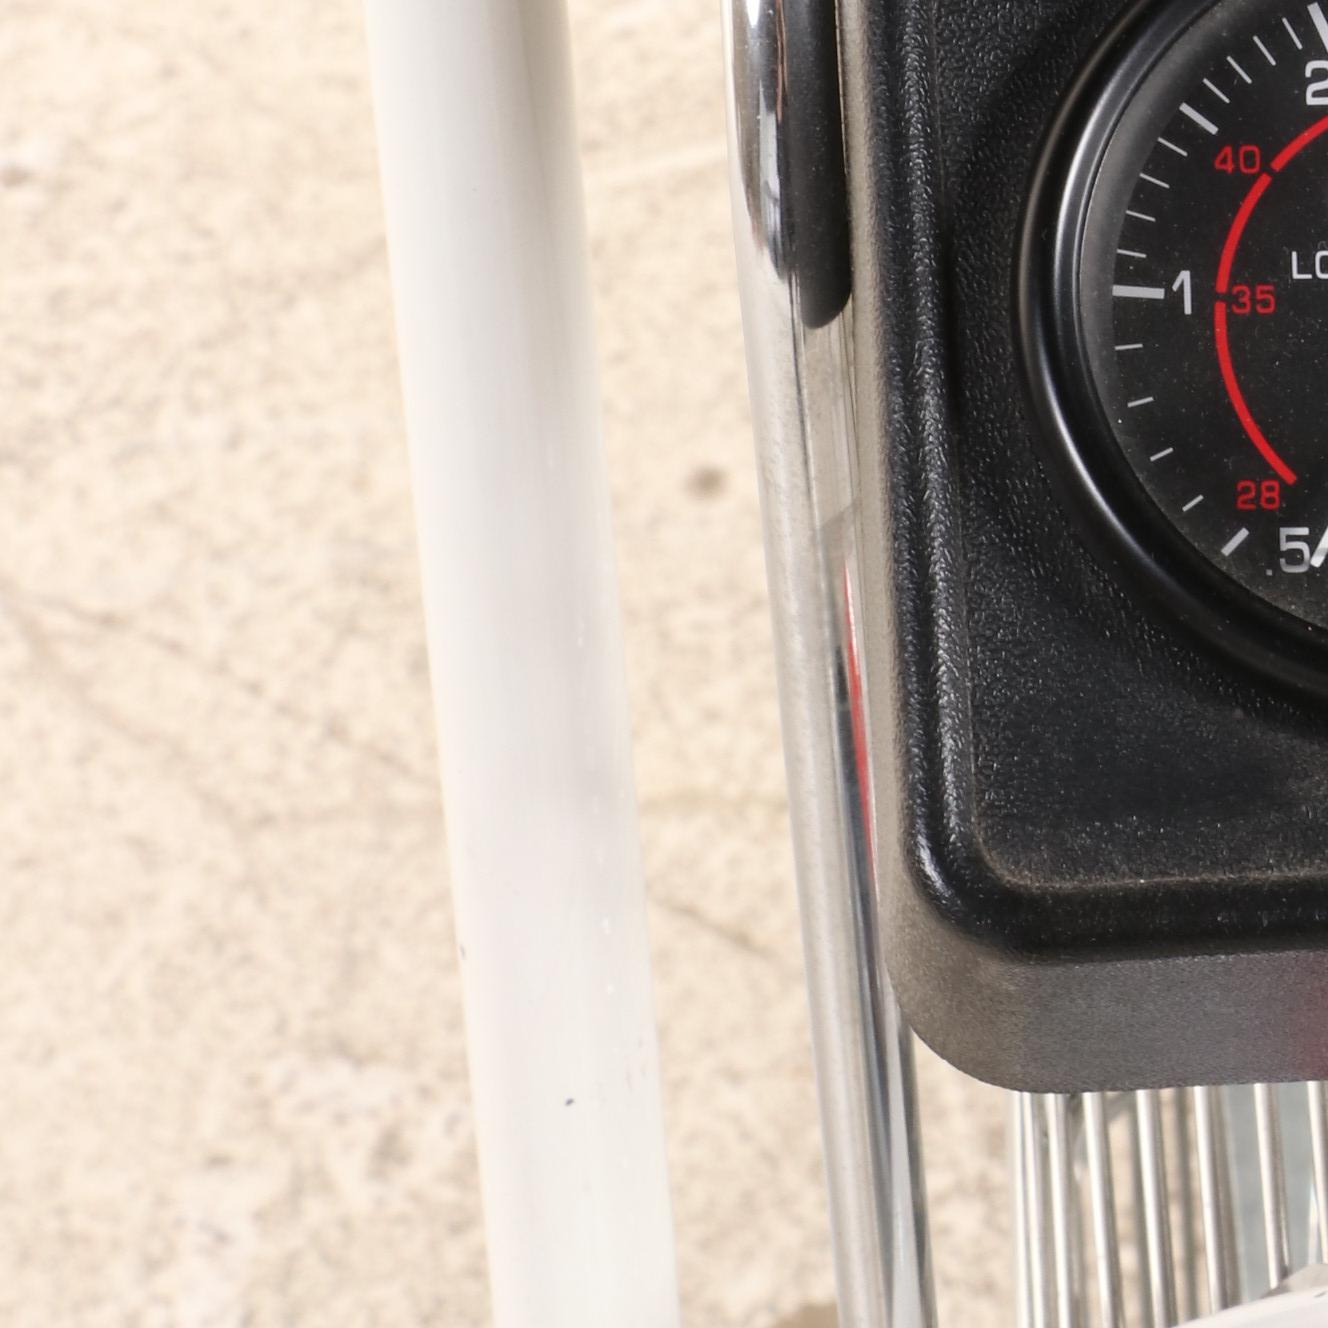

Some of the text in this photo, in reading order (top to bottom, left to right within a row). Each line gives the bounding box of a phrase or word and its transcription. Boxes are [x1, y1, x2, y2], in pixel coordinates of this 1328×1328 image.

[1214, 145, 1262, 174] 40
[1172, 270, 1192, 315] 1
[1231, 285, 1276, 315] 35
[1236, 480, 1281, 511] 28
